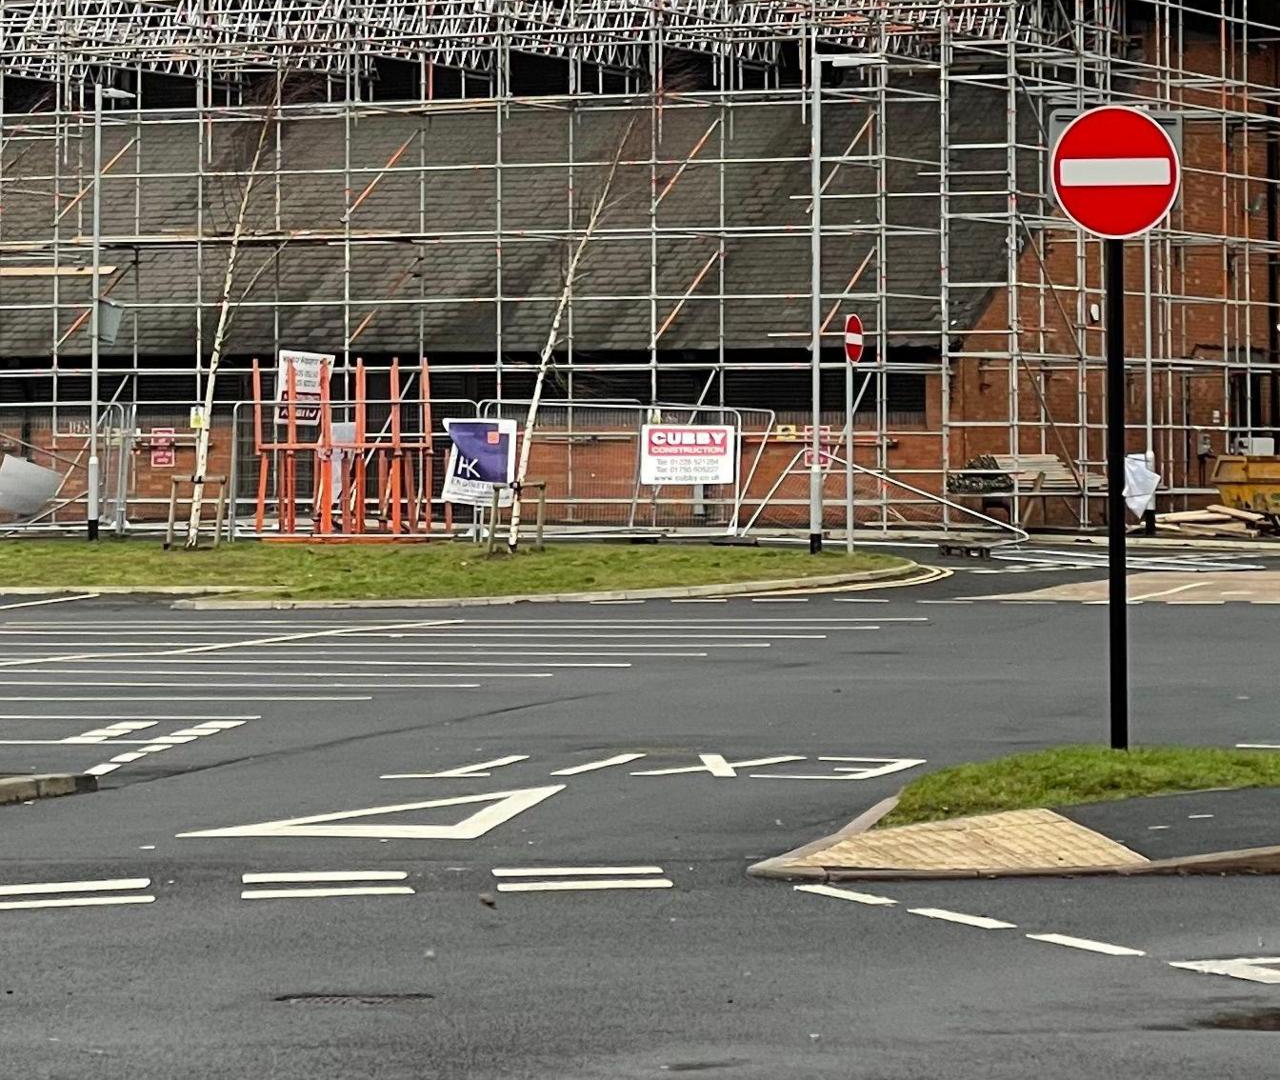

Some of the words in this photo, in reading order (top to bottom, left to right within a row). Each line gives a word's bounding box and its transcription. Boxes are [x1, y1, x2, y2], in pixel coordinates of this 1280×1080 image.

[651, 432, 726, 445] CUBBY
[651, 446, 725, 454] CONSTRUCTION
[380, 754, 926, 780] EXIT
